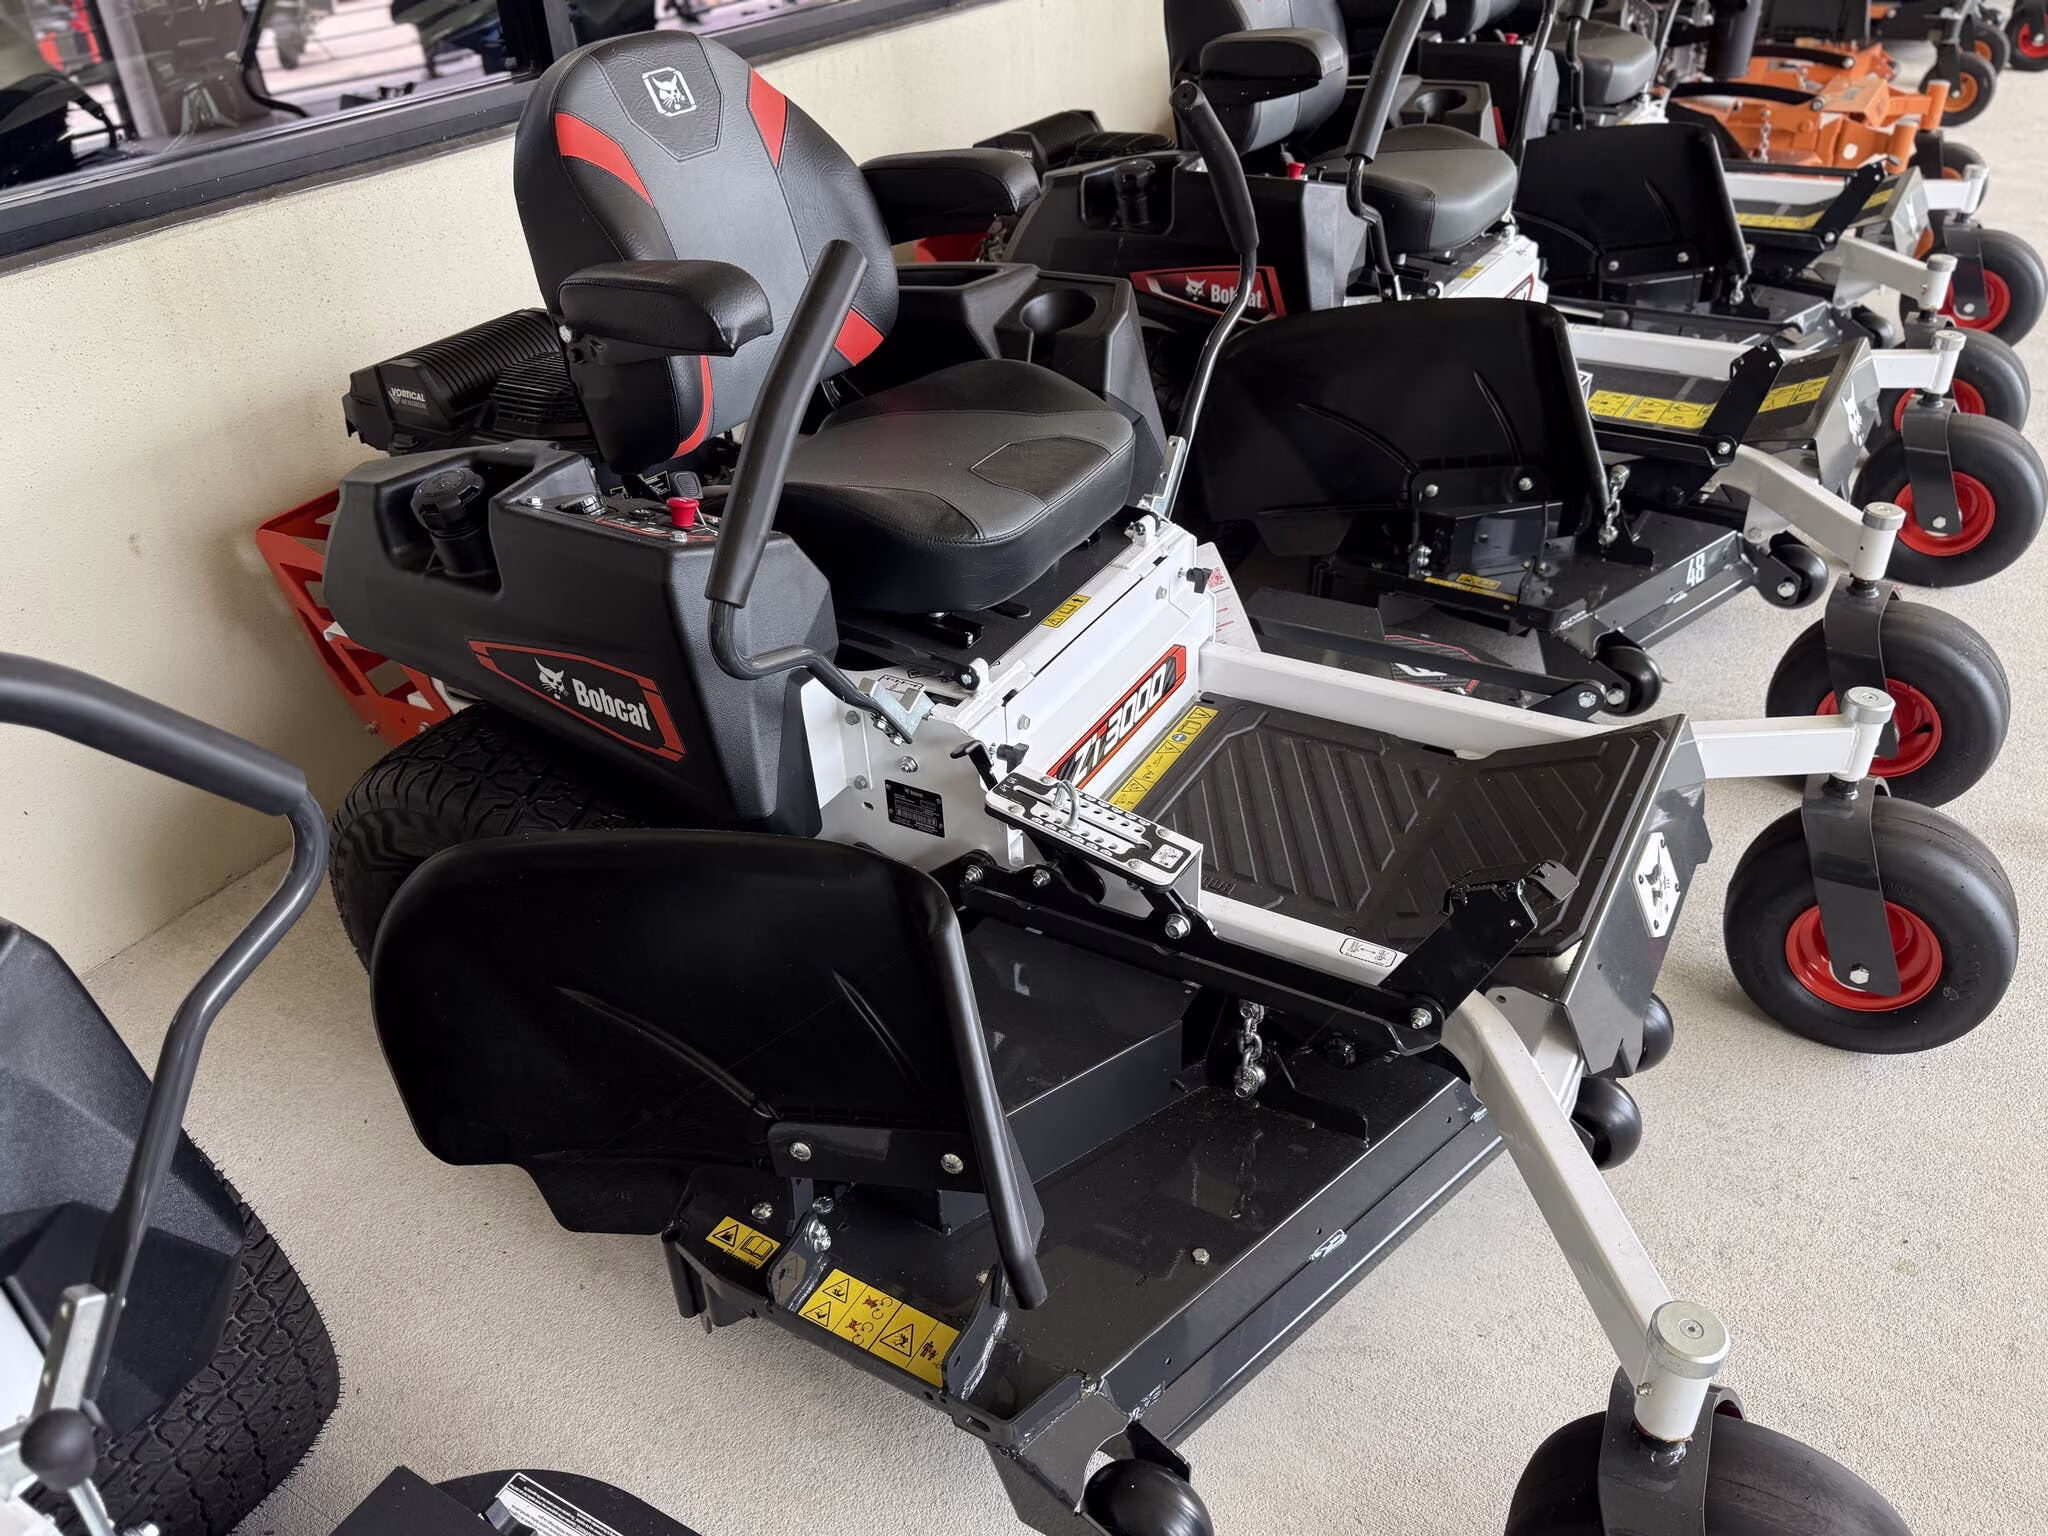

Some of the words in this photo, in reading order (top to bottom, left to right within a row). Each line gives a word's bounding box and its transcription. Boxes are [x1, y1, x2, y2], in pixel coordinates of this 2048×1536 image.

[391, 387, 426, 402] VORTICAL
[1686, 551, 1705, 587] 48
[571, 678, 651, 731] Bobcat
